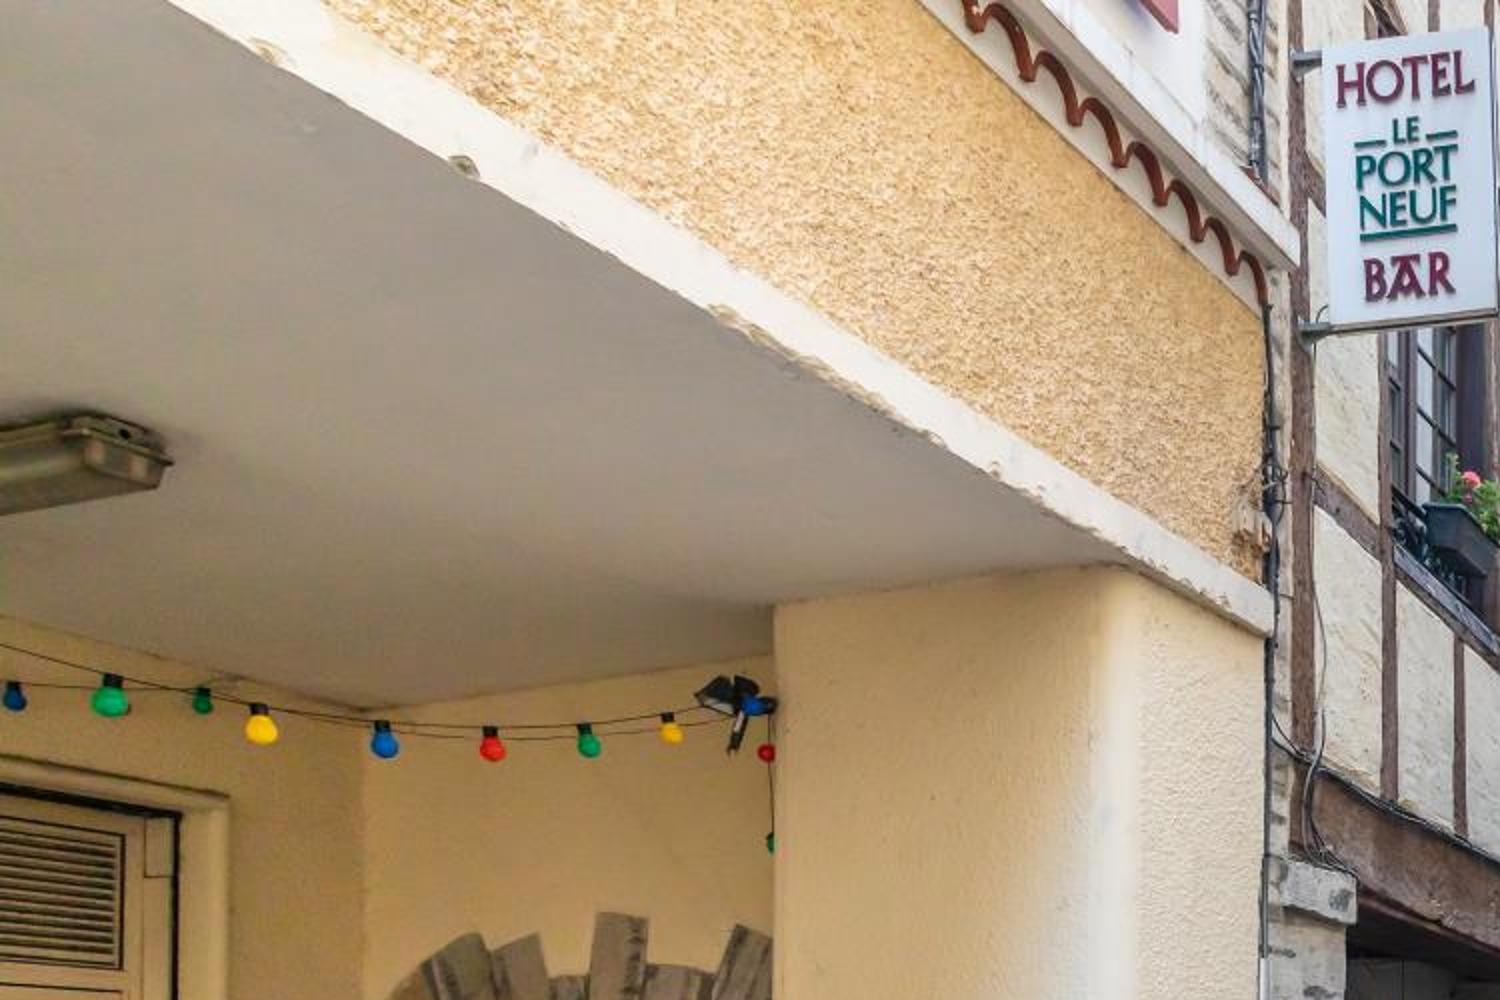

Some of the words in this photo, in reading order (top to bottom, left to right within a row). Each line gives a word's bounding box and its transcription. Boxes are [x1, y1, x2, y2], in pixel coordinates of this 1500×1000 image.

[1335, 50, 1476, 109] HOTEL
[1392, 115, 1421, 145] LE
[1355, 143, 1459, 191] PORT
[1359, 184, 1458, 230] NEUF
[1363, 250, 1457, 303] BAR
